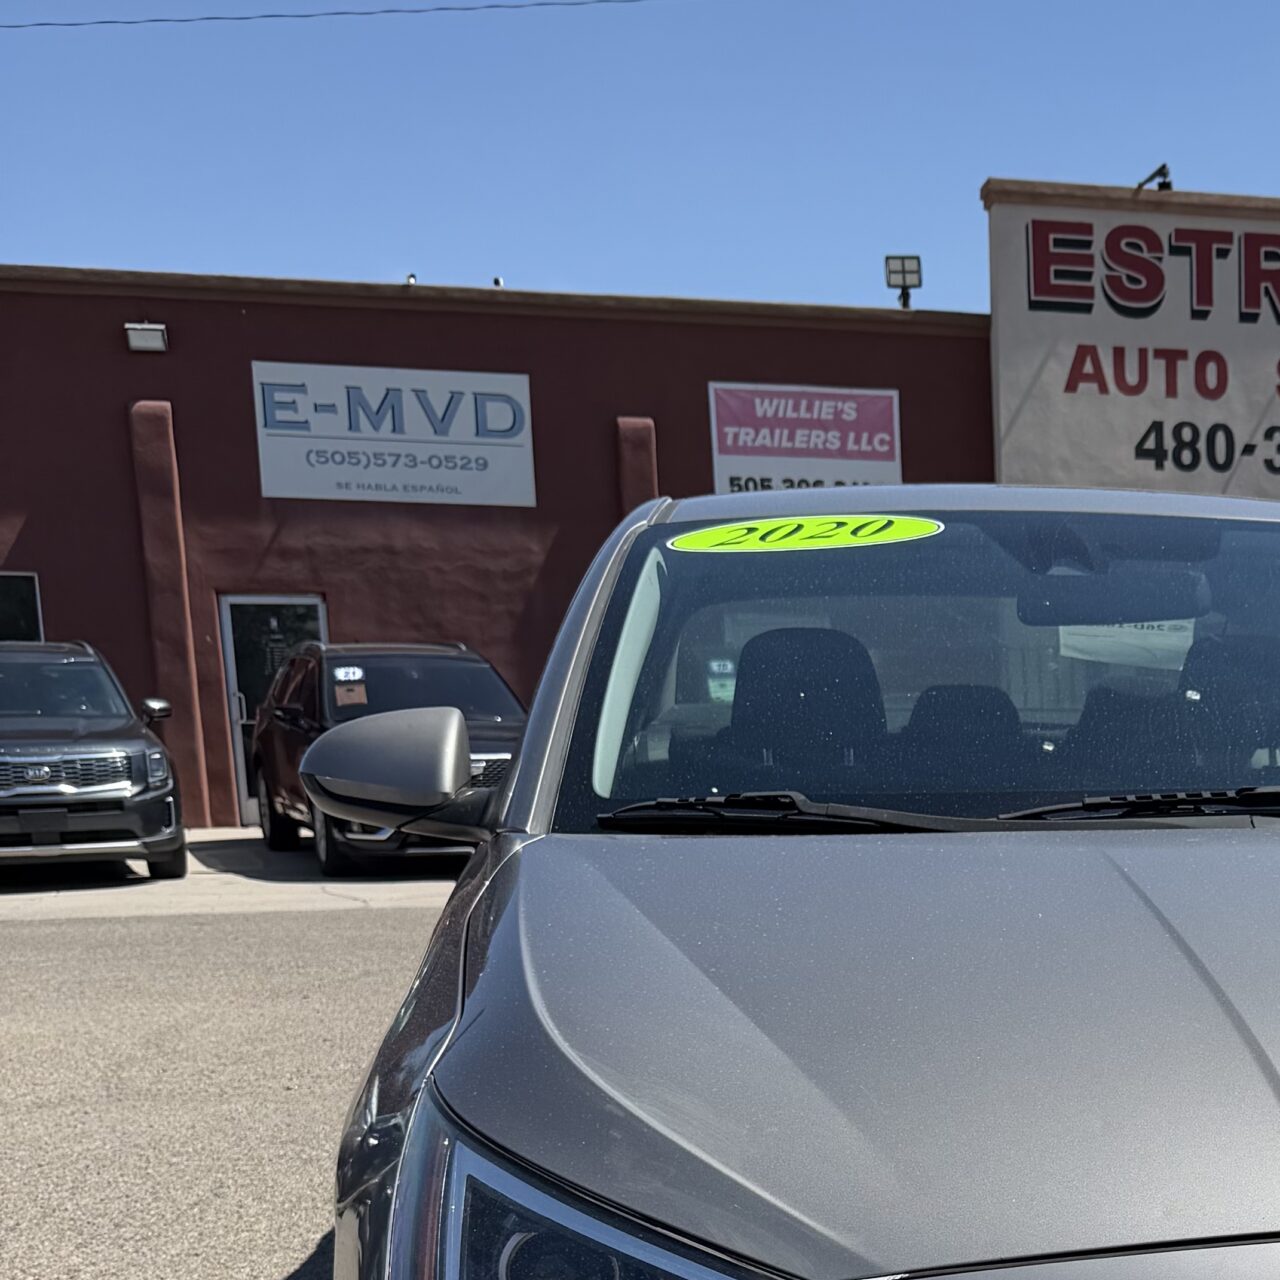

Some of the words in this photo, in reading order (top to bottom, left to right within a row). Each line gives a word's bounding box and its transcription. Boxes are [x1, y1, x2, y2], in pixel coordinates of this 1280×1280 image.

[1063, 343, 1229, 400] AUTO
[259, 381, 526, 440] E-MVD
[754, 397, 858, 421] WILLIE'S
[723, 426, 841, 451] TRAILERS
[847, 431, 891, 452] LLC
[305, 449, 488, 472] (505)573-0529
[335, 481, 353, 491] SE
[356, 482, 399, 493] HABLA
[402, 482, 463, 495] ESPAÑOL
[709, 518, 896, 549] 2020
